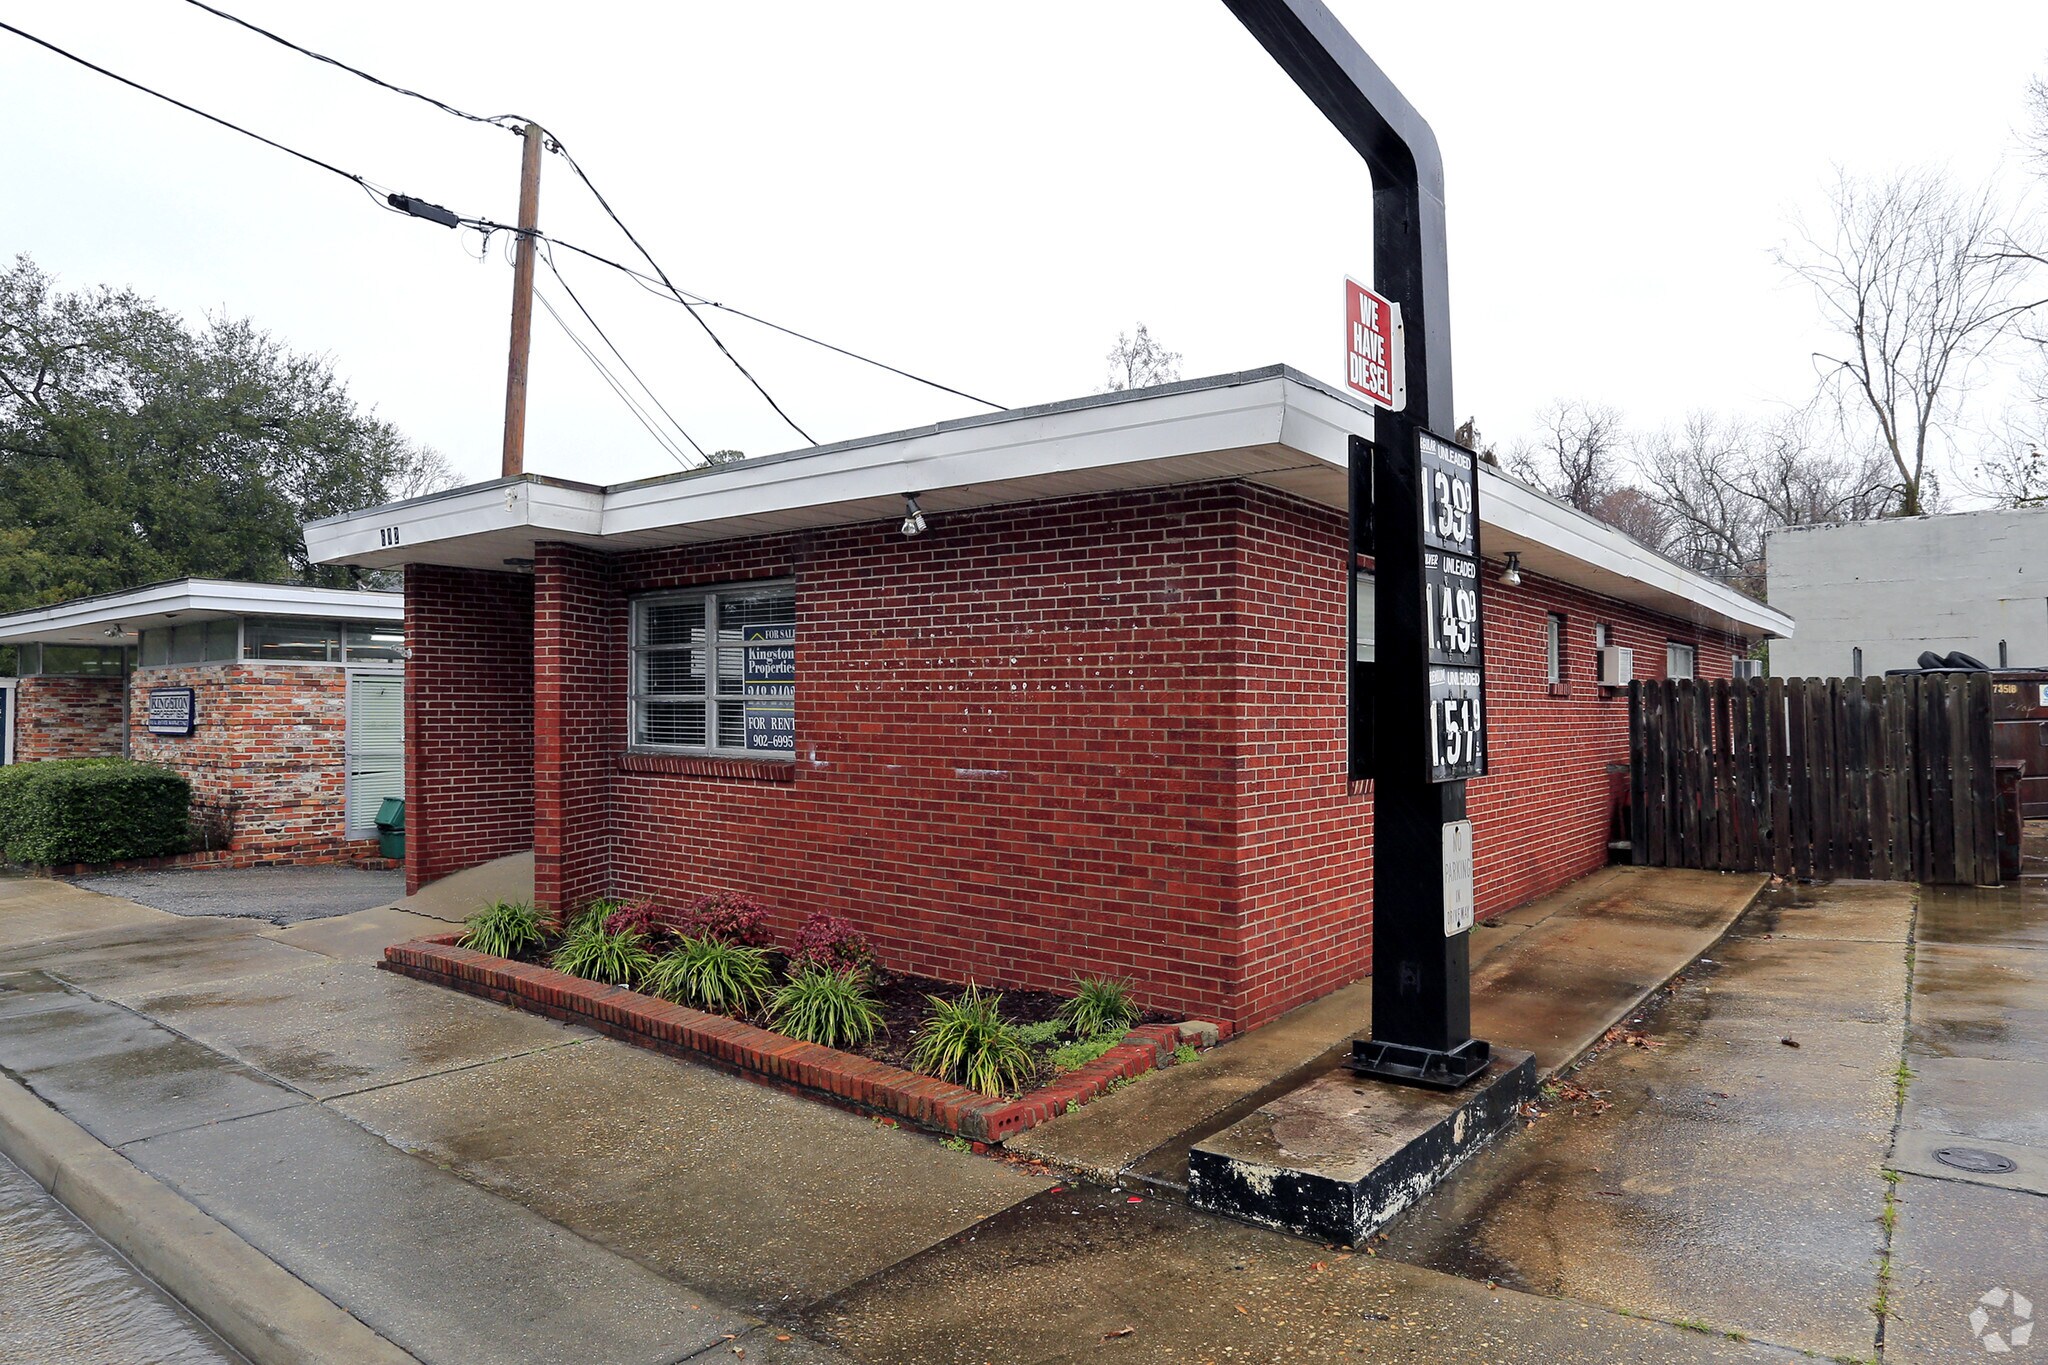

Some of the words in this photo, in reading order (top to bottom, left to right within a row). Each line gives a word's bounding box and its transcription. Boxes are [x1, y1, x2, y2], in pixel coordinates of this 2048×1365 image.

[1359, 292, 1379, 333] WE
[1353, 320, 1385, 367] HAVE
[1349, 350, 1391, 401] DIESEL
[1437, 444, 1472, 471] UNLEADED
[1443, 556, 1476, 579] UNLEADED
[765, 629, 779, 640] FOR
[748, 647, 795, 665] Kingston
[748, 660, 796, 679] Properties
[1447, 671, 1480, 687] UNLEADED
[151, 698, 188, 709] KINGSTON
[748, 716, 766, 730] FOR
[770, 717, 796, 730] RENT
[753, 734, 794, 748] 902-6995
[1445, 858, 1471, 884] PARKING
